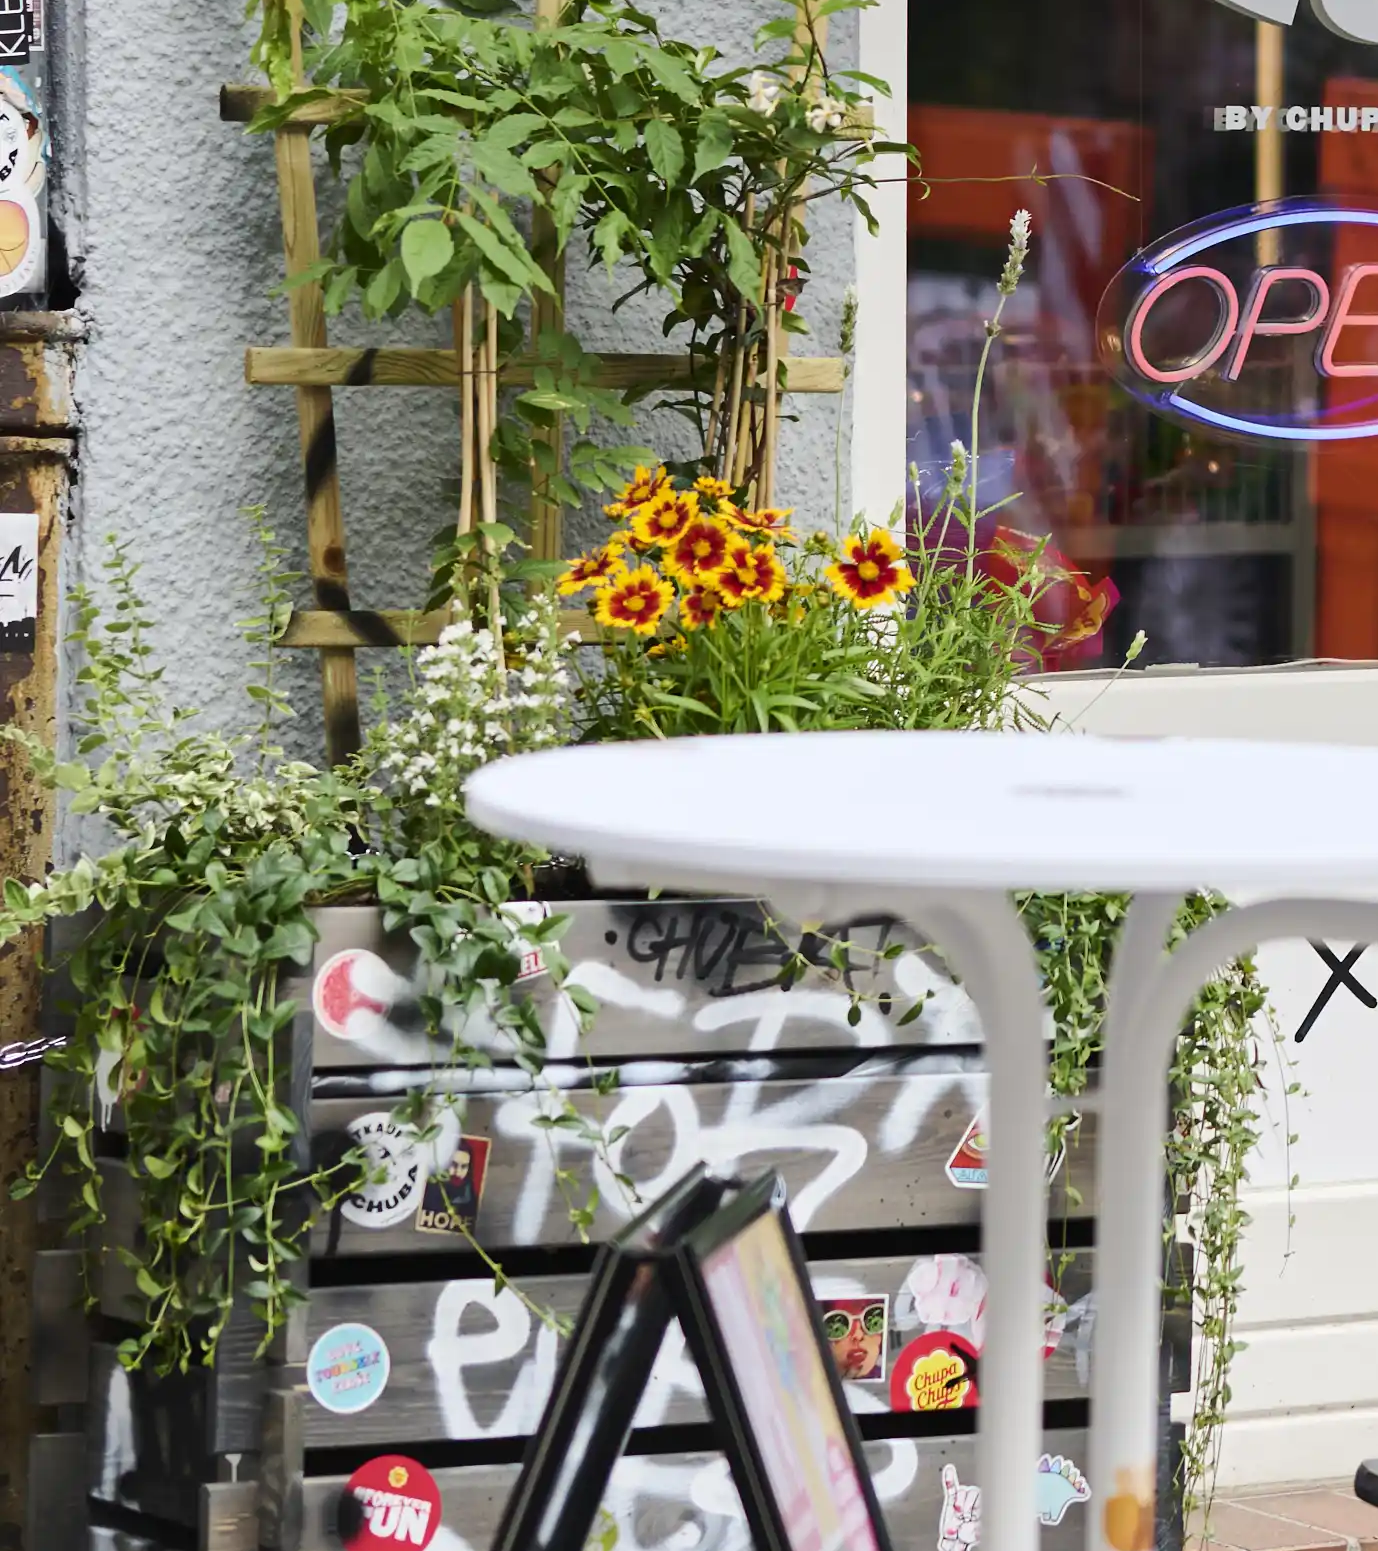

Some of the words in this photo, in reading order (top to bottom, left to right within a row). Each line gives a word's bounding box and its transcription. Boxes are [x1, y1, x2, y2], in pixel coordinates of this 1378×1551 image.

[1224, 105, 1274, 132] BY
[349, 1164, 419, 1213] CHUBA
[914, 1362, 958, 1392] Chupa
